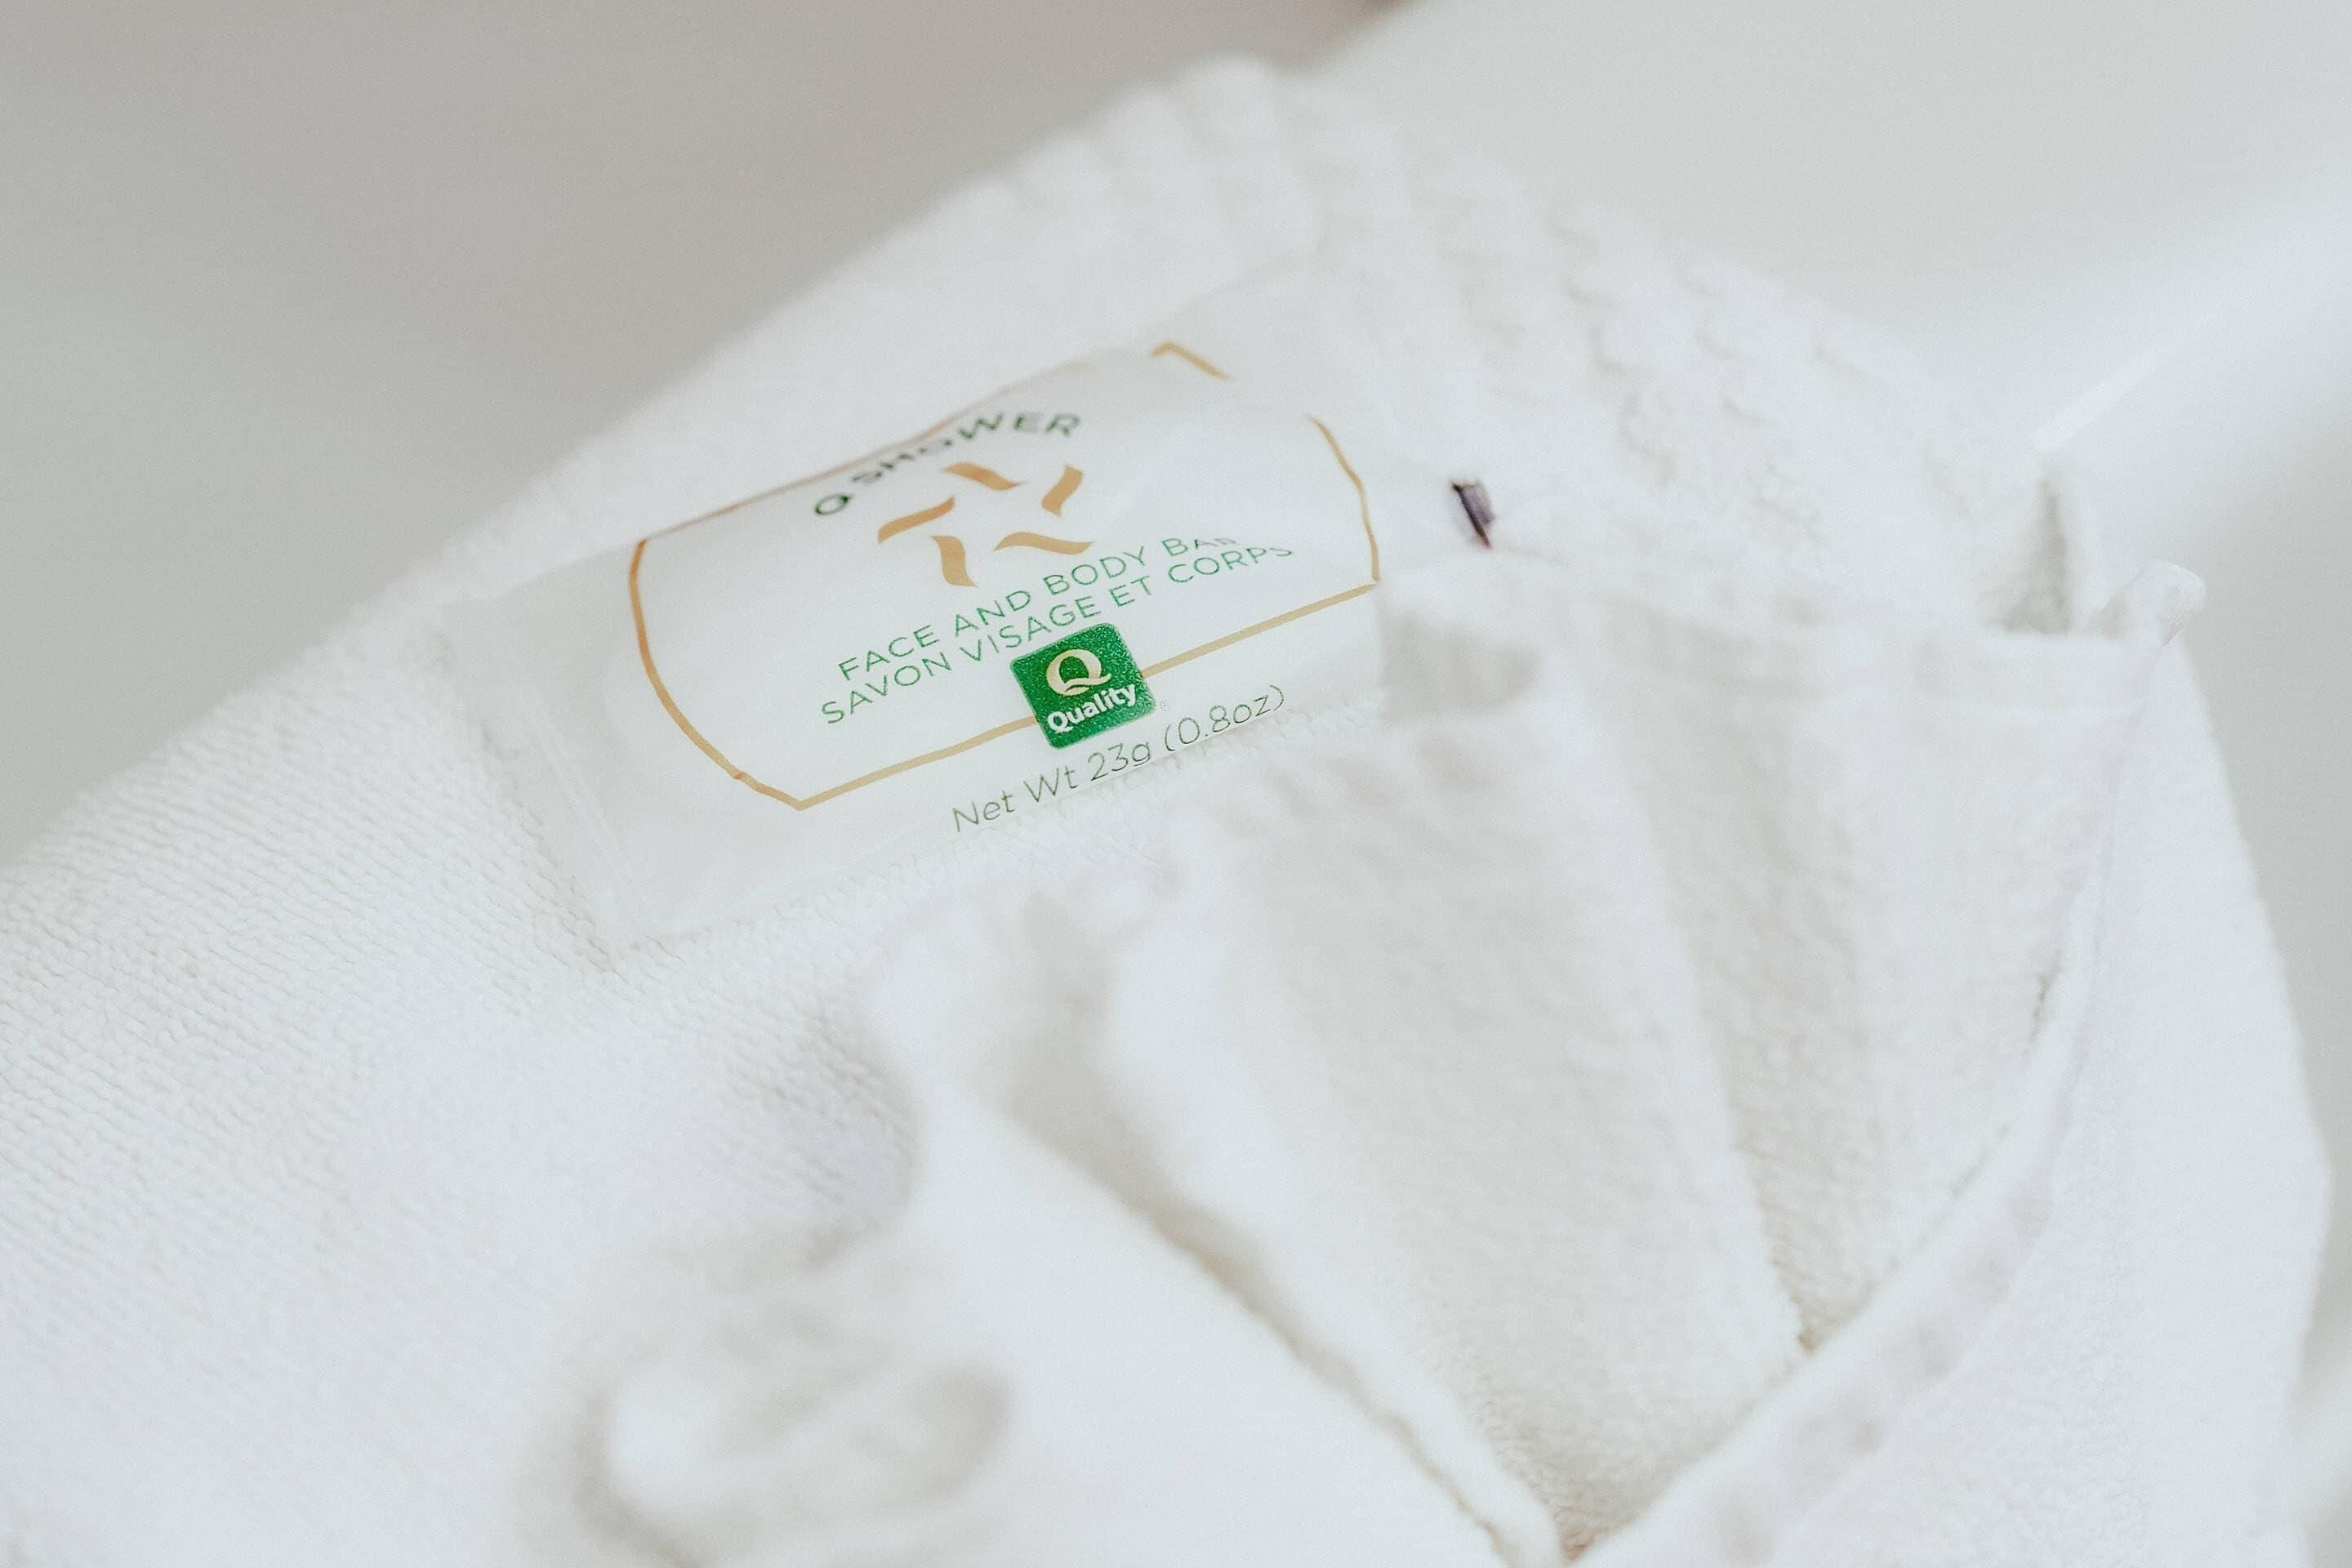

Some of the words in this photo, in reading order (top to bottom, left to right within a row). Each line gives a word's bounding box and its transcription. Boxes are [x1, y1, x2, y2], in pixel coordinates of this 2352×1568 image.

[822, 653, 952, 724] SAVON
[959, 596, 1102, 662] VISAGE
[1108, 575, 1152, 608] ET
[1168, 546, 1293, 583] CORPS
[839, 626, 940, 681] FACE
[954, 590, 1031, 638] AND
[1044, 546, 1146, 596] BODY
[1046, 648, 1111, 696] Q
[952, 791, 1014, 831] Net
[1023, 765, 1078, 803] Wt
[1087, 742, 1152, 782] 23g
[1164, 684, 1285, 752] (0.8oz)
[1047, 683, 1138, 734] Quality
